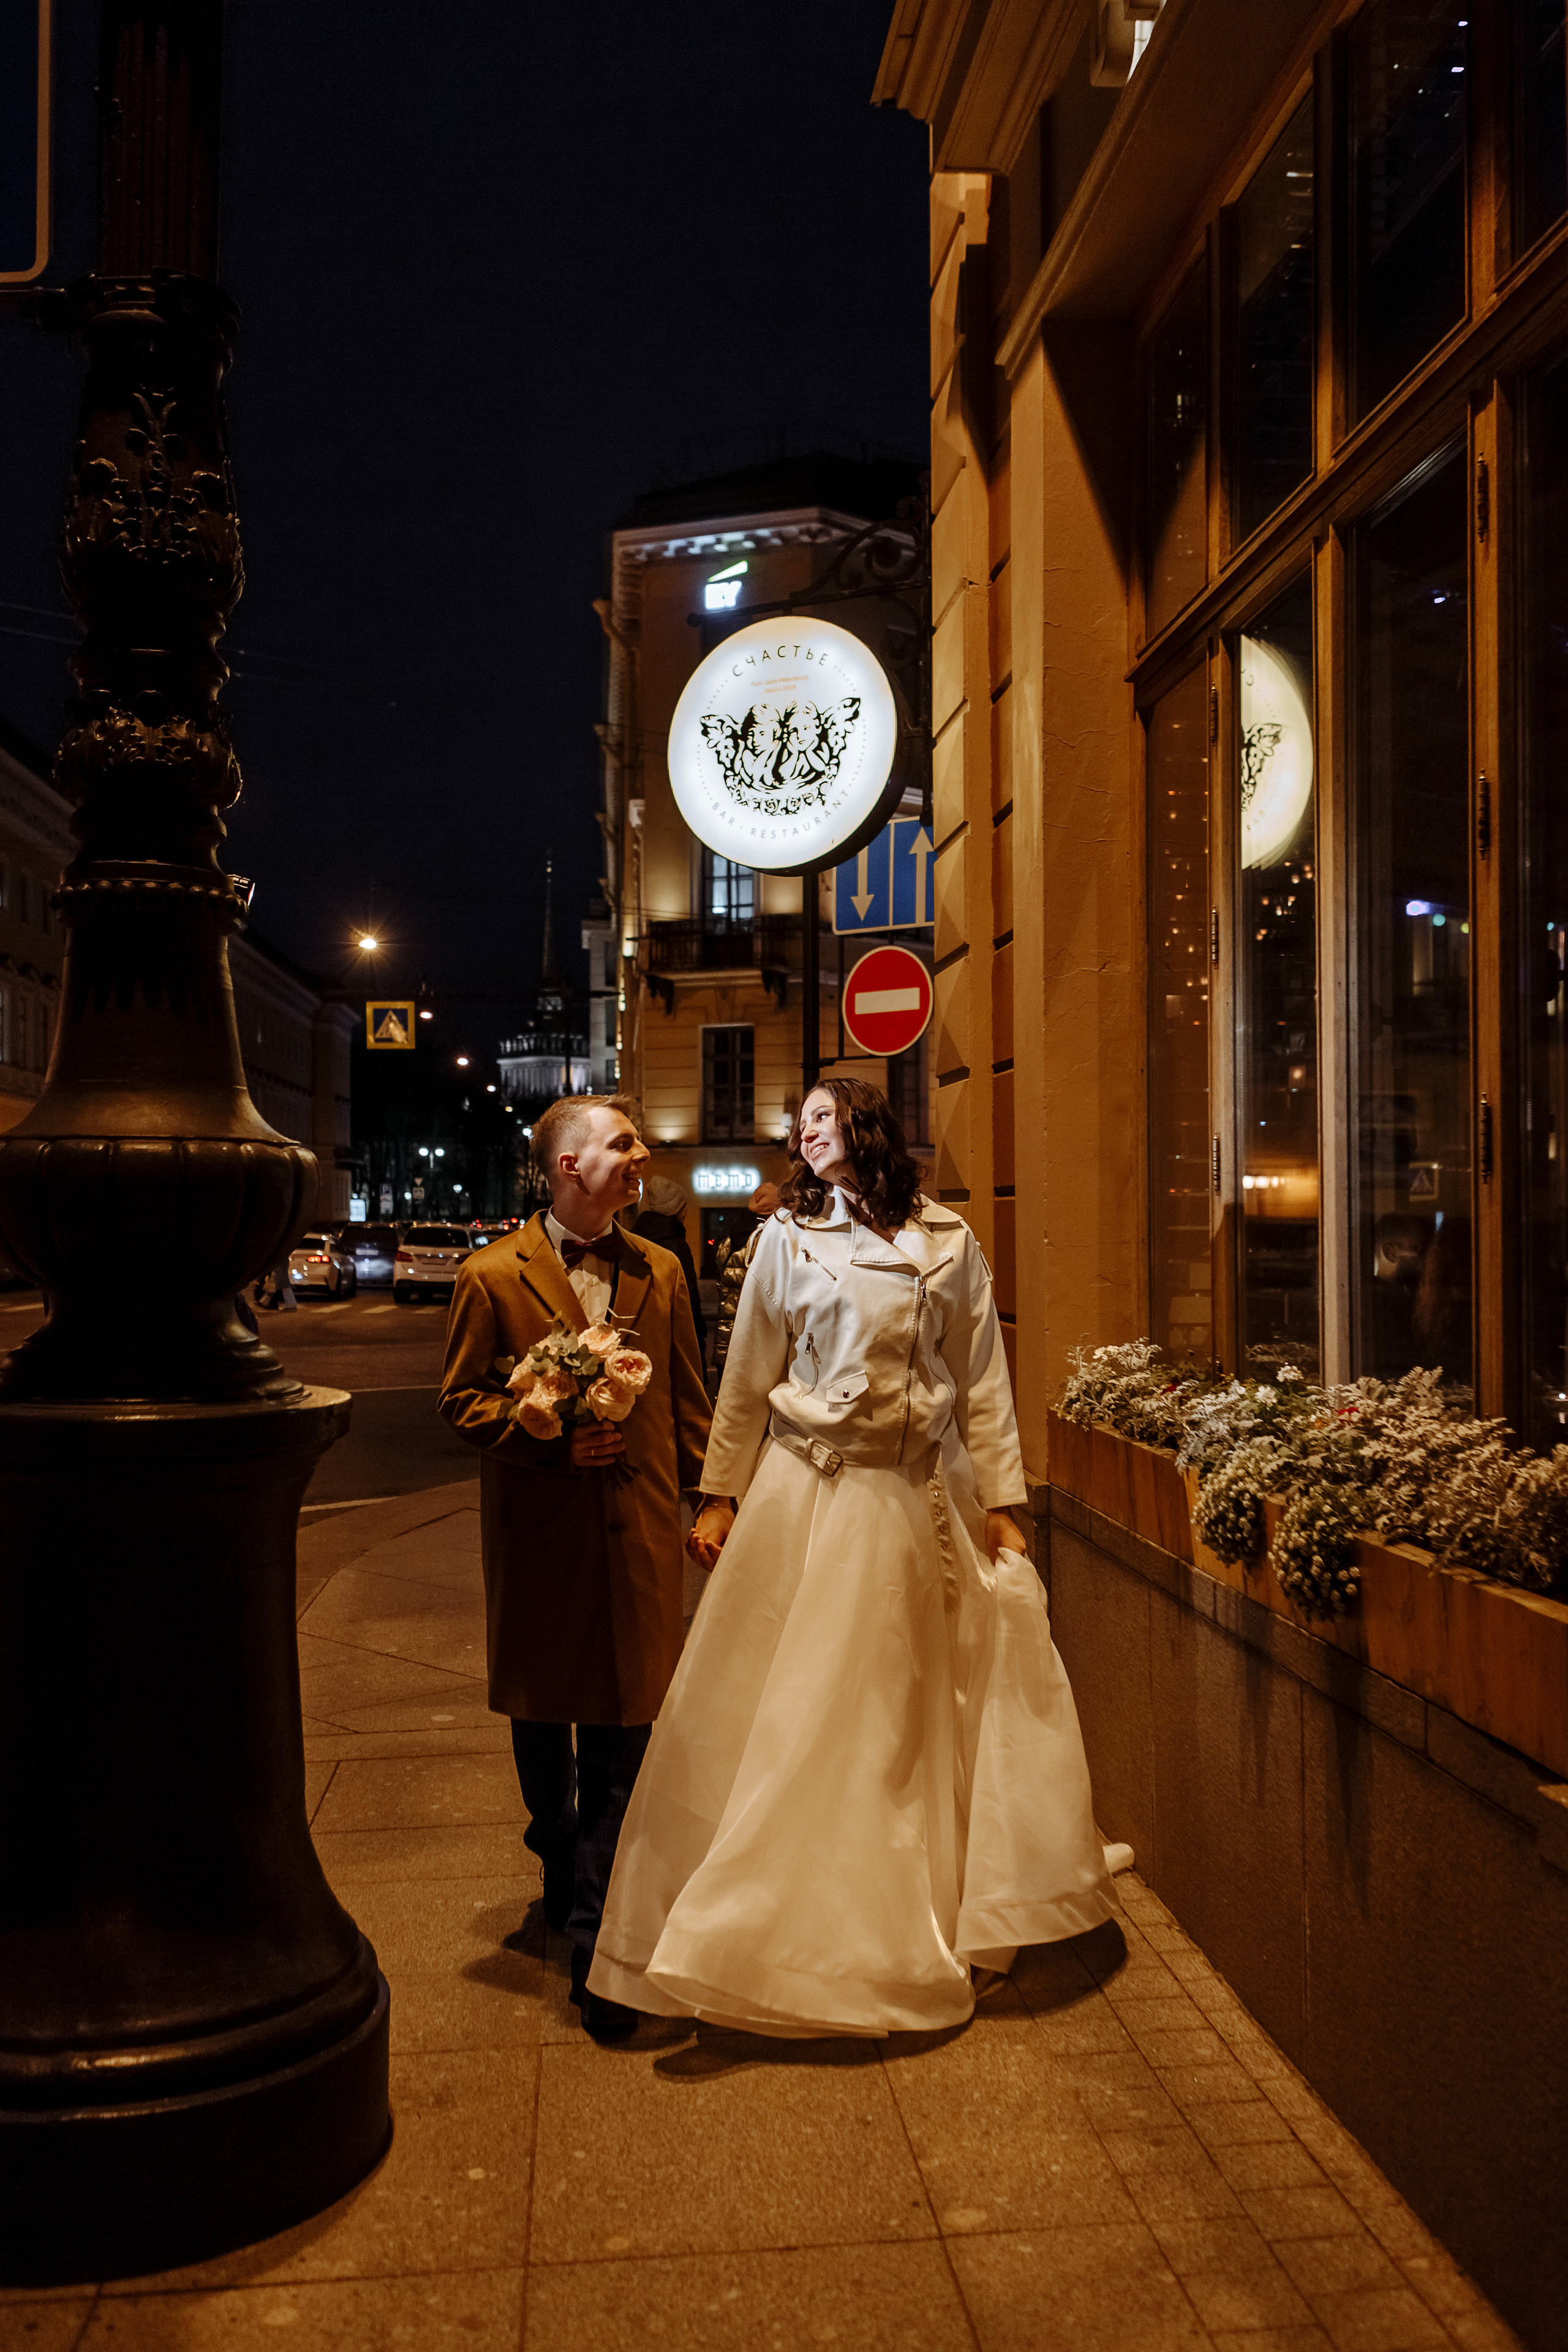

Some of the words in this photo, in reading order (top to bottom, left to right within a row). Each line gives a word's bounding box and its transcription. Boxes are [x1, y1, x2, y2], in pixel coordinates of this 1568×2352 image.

[732, 645, 829, 676] СЧАСТЬЕ
[712, 802, 735, 826] BAR
[750, 790, 849, 839] RESTAURANT
